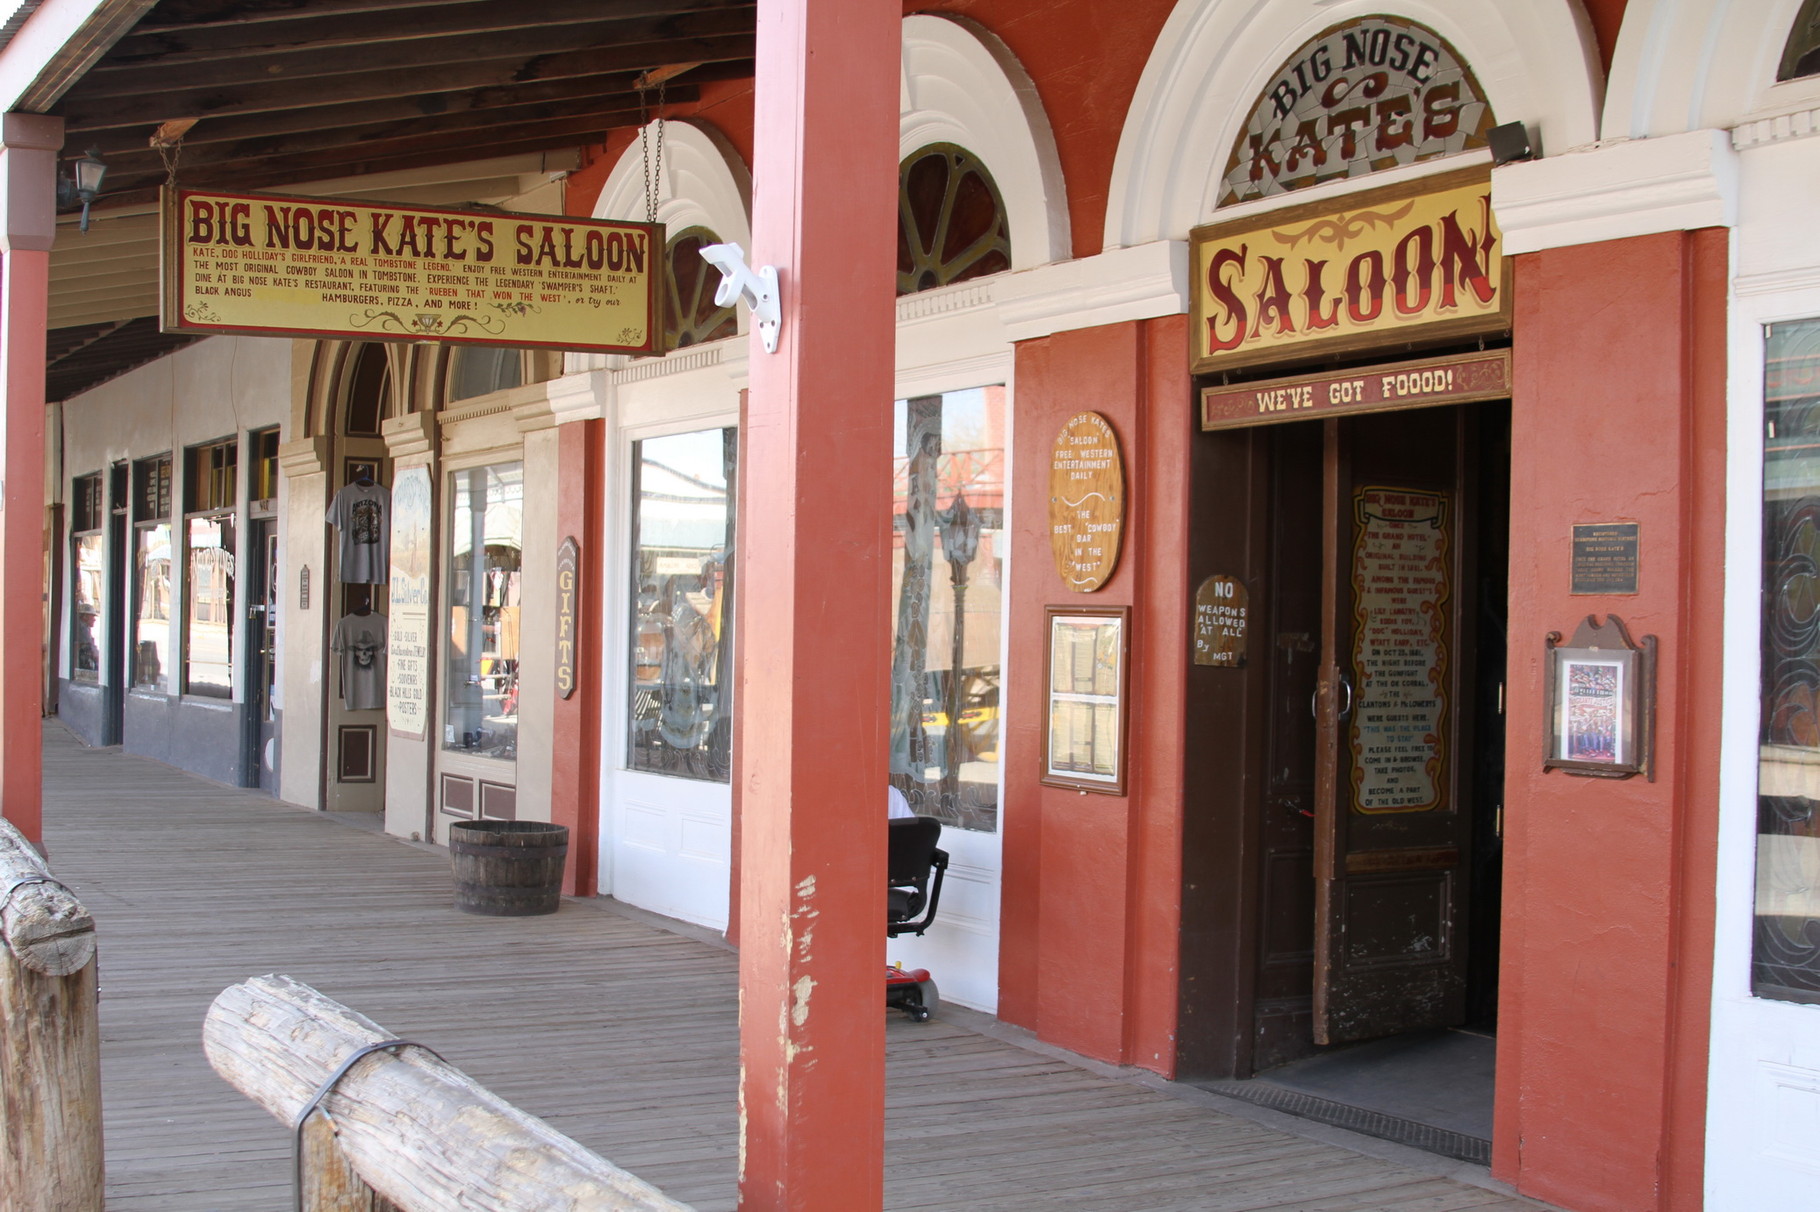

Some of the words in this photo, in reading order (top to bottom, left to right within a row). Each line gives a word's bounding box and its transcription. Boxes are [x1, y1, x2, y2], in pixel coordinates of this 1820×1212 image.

[1271, 45, 1331, 121] BIG
[1343, 29, 1438, 83] NOSE
[189, 200, 255, 247] BIG
[263, 205, 358, 253] NOSE
[371, 212, 494, 262] KATE'S
[516, 224, 646, 273] SALOON
[193, 248, 219, 258] KATE,
[222, 249, 238, 260] DOC
[242, 250, 286, 261] HOLLIDAY'S
[351, 257, 368, 266] REAL
[374, 258, 417, 270] TOMBSTONE
[463, 264, 485, 273] ENJOY
[490, 266, 506, 275] FREE
[511, 268, 543, 277] WESTERN
[548, 271, 602, 281] ENTERTAINMENT
[608, 275, 625, 283] DAILY
[194, 260, 209, 269] THE
[216, 262, 239, 271] MOST
[244, 263, 278, 274] ORIGINAL
[286, 266, 317, 276] COWBOY
[325, 268, 353, 278] SALOON
[360, 270, 367, 279] IN
[373, 270, 420, 283] TOMBSTONE.
[428, 274, 469, 285] EXPERIENCE
[475, 277, 488, 286] THE
[496, 278, 534, 289] LEGENDARY
[1206, 192, 1497, 356] SALOON
[196, 273, 212, 283] DINE
[217, 274, 227, 283] AT
[233, 275, 244, 284] BIG
[249, 276, 267, 286] NOSE
[273, 277, 298, 287] KATE'S
[360, 283, 399, 294] FEATURING
[406, 286, 419, 294] THE
[466, 289, 486, 298] THAT
[493, 291, 512, 300] WON
[519, 292, 533, 301] THE
[589, 297, 601, 308] try
[196, 286, 219, 295] BLACK
[225, 288, 251, 297] ANGUS
[424, 299, 442, 308] AND
[1257, 386, 1313, 412] WE'VE
[1330, 380, 1364, 405] GOT
[1382, 370, 1454, 399] FOOOD!
[1069, 415, 1088, 429] NOSE
[1056, 450, 1072, 459] FREE
[1080, 449, 1114, 458] WESTERN
[1054, 459, 1111, 470] ENTERTAINMENT
[1071, 471, 1093, 480] DAILY
[352, 499, 382, 516] ARIZONA
[1077, 510, 1090, 519] THE
[1054, 524, 1072, 534] BEST
[1077, 534, 1091, 542] BAR
[1075, 548, 1082, 556] IN
[1088, 547, 1102, 556] THE
[1215, 582, 1233, 598] NO
[1198, 605, 1246, 617] WEAPONS
[1198, 615, 1245, 628] ALLOWED
[558, 570, 573, 690] GIFTS
[1200, 626, 1212, 635] AT
[1222, 627, 1242, 637] ALL
[1213, 652, 1232, 661] MGT
